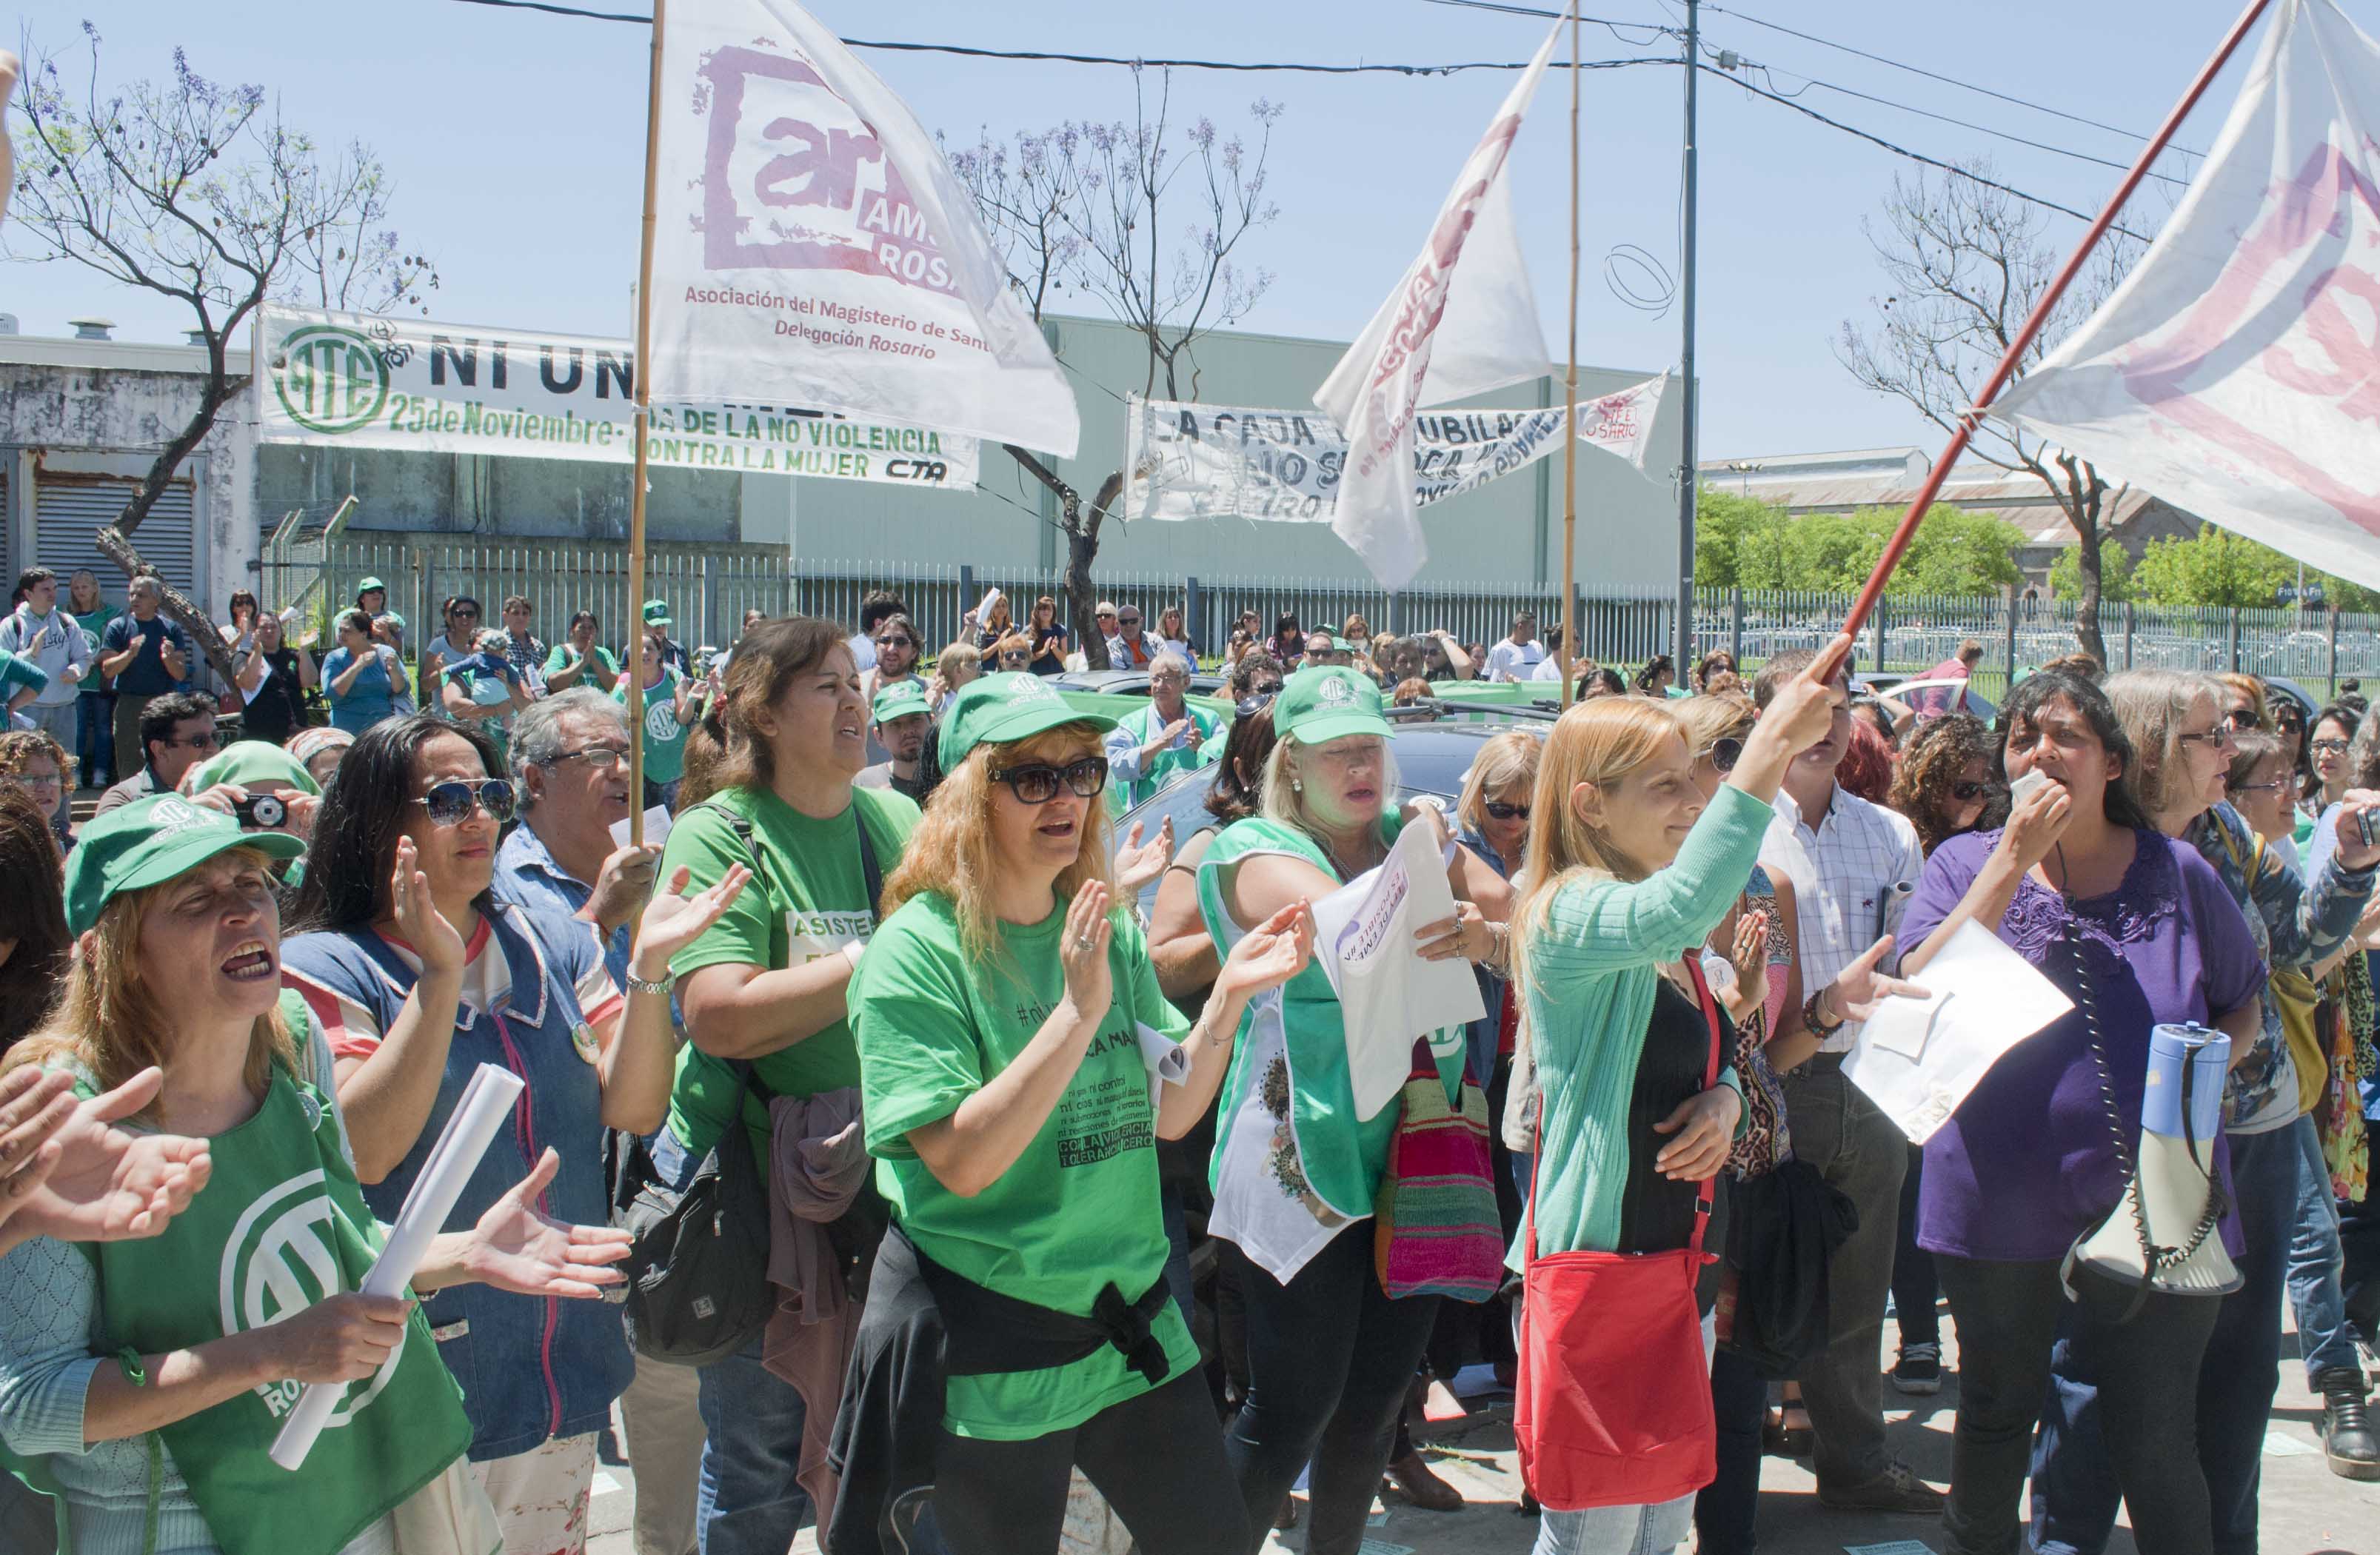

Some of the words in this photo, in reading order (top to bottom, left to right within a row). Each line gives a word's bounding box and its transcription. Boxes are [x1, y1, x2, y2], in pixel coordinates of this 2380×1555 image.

[863, 196, 937, 246] AM
[879, 243, 958, 291] ROS
[685, 285, 784, 309] Asociación
[789, 298, 815, 315] del
[820, 301, 917, 332] Magisterio
[922, 321, 946, 338] de
[951, 328, 993, 354] Sant
[775, 319, 864, 348] Delegación
[869, 335, 935, 360] Rosario
[430, 335, 509, 389] NI
[540, 345, 634, 401] UN
[649, 405, 675, 433] IA
[683, 408, 717, 435] DE
[768, 416, 801, 443] NO
[808, 420, 942, 455] VIOLENCIA
[1414, 412, 1527, 445] UBILA
[743, 447, 775, 469] LA
[784, 449, 869, 478] MUJER
[886, 459, 947, 481] CTA
